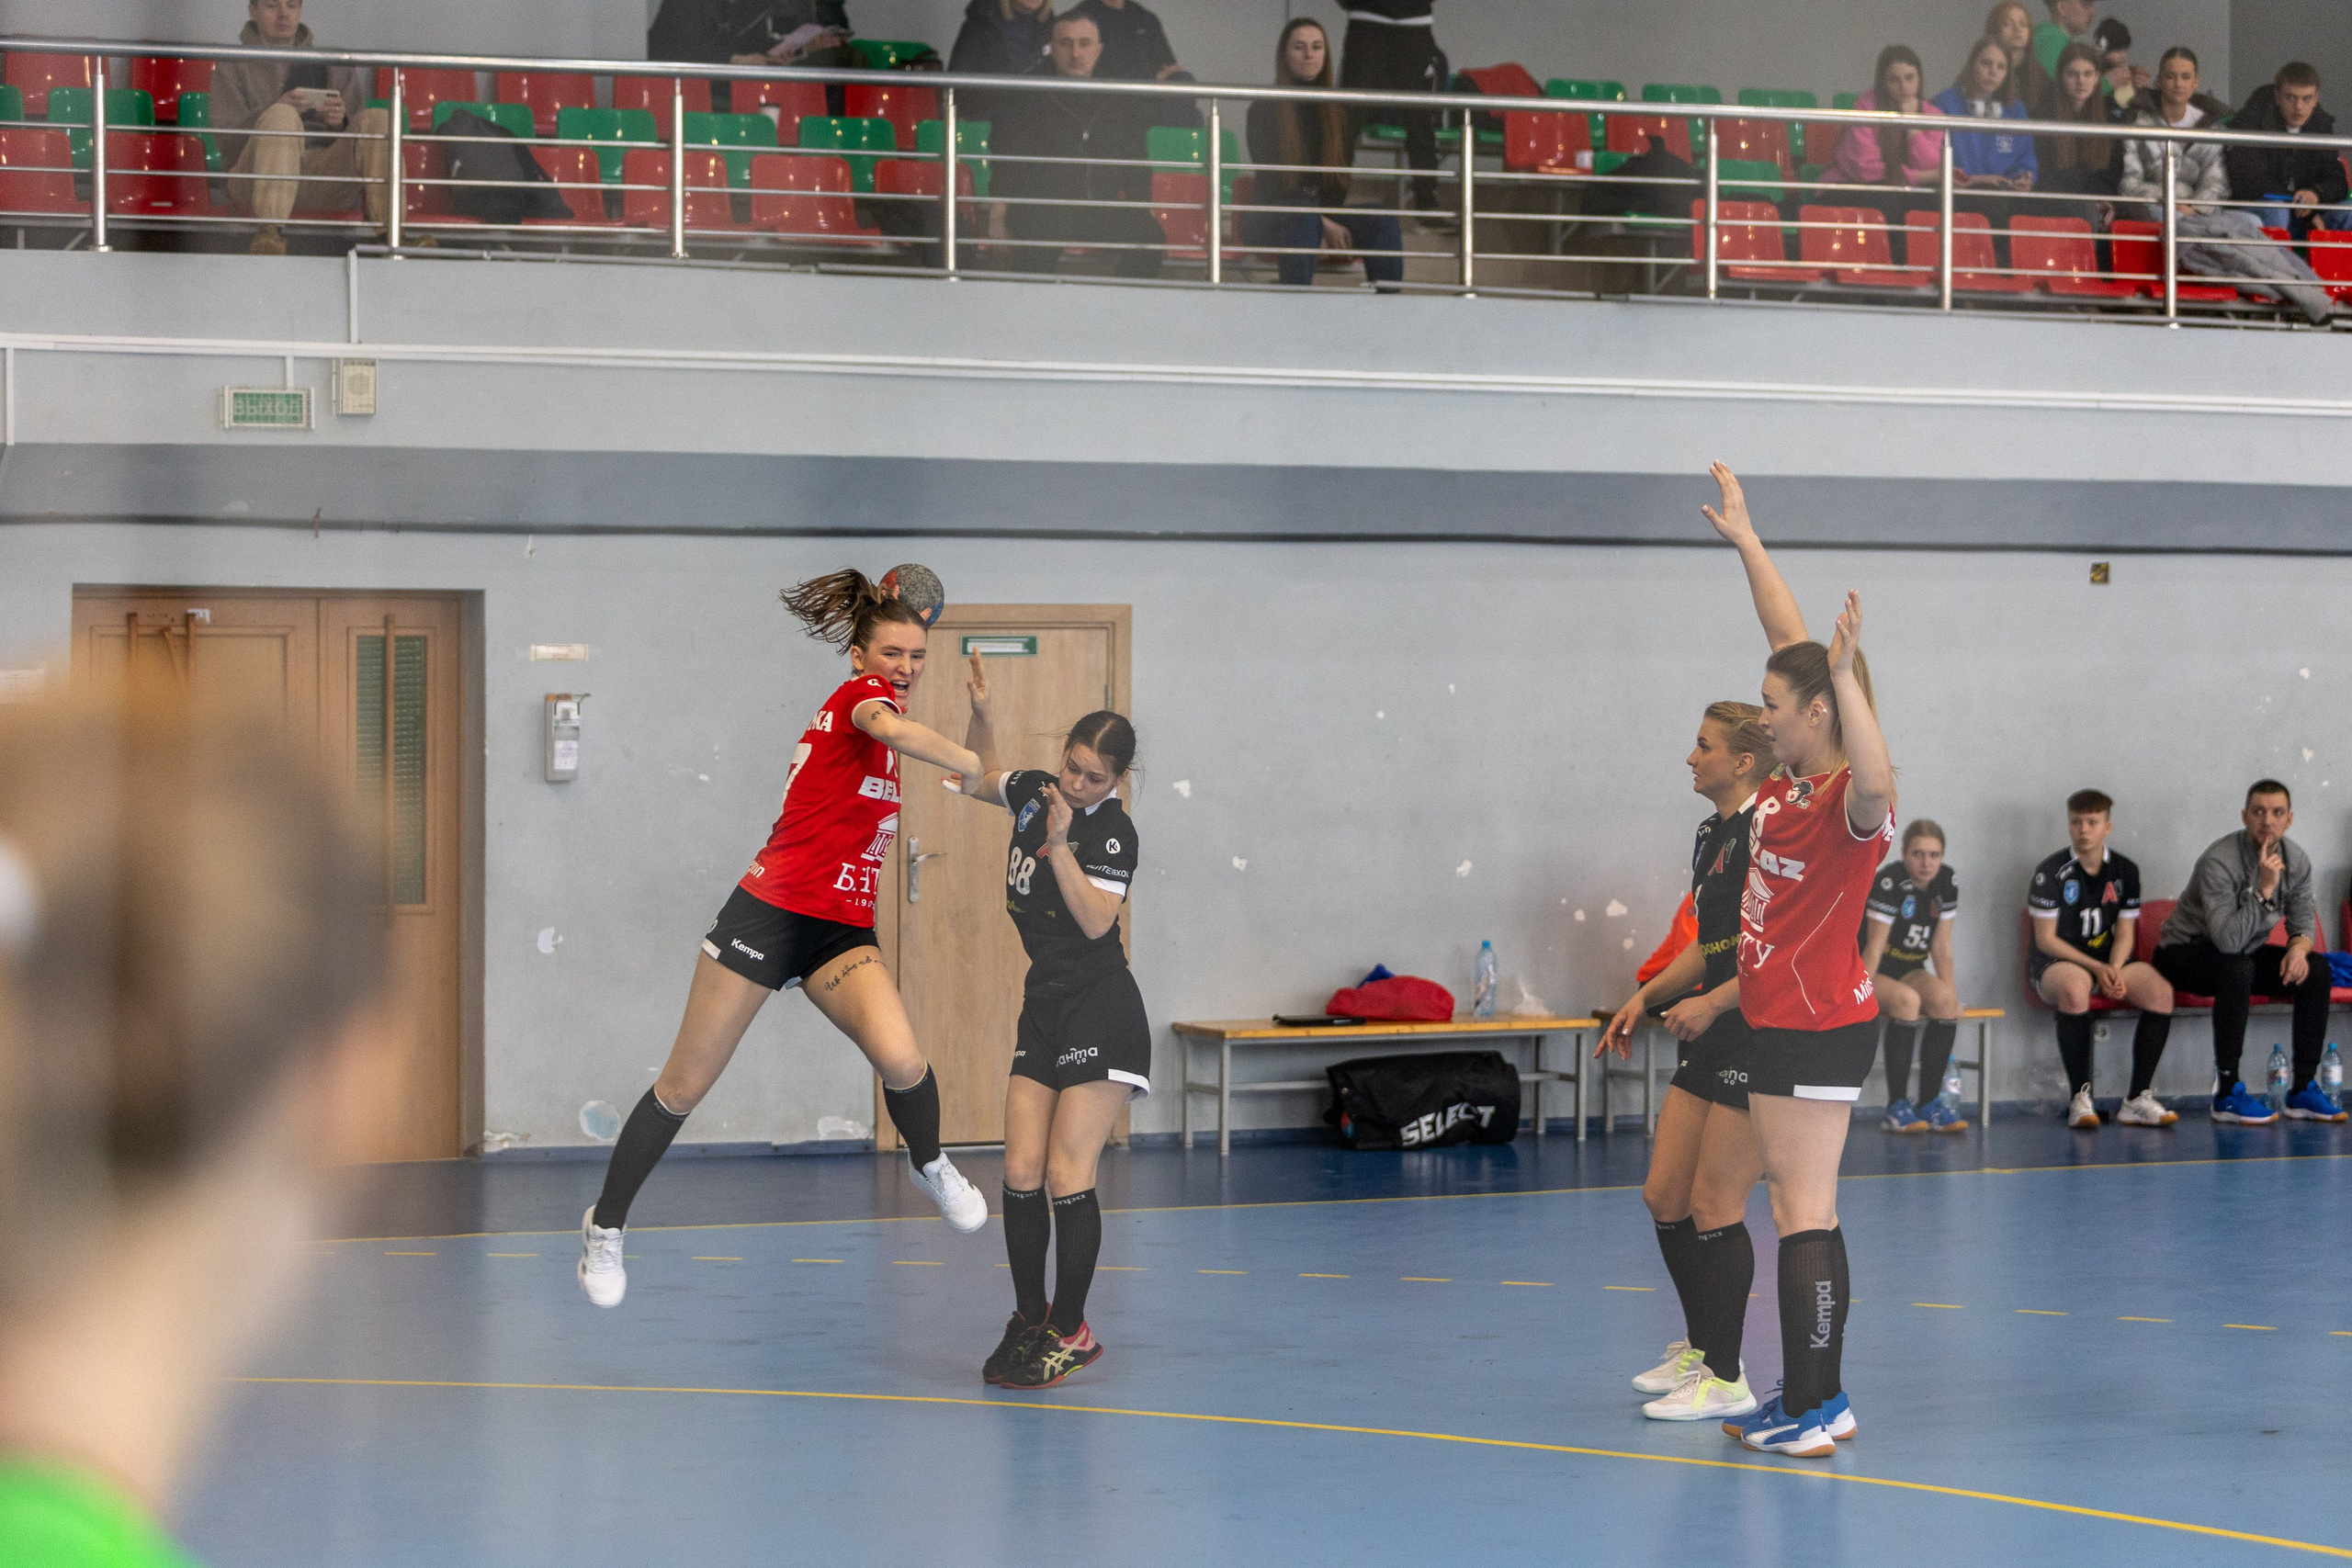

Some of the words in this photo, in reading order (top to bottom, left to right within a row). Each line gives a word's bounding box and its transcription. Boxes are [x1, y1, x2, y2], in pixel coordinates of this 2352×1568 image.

[857, 775, 902, 804] BEL
[1008, 846, 1036, 896] 88
[2079, 907, 2104, 938] 11
[730, 937, 765, 962] Kempa
[1399, 1101, 1497, 1147] SELECT
[1809, 1280, 1836, 1349] Kempa
